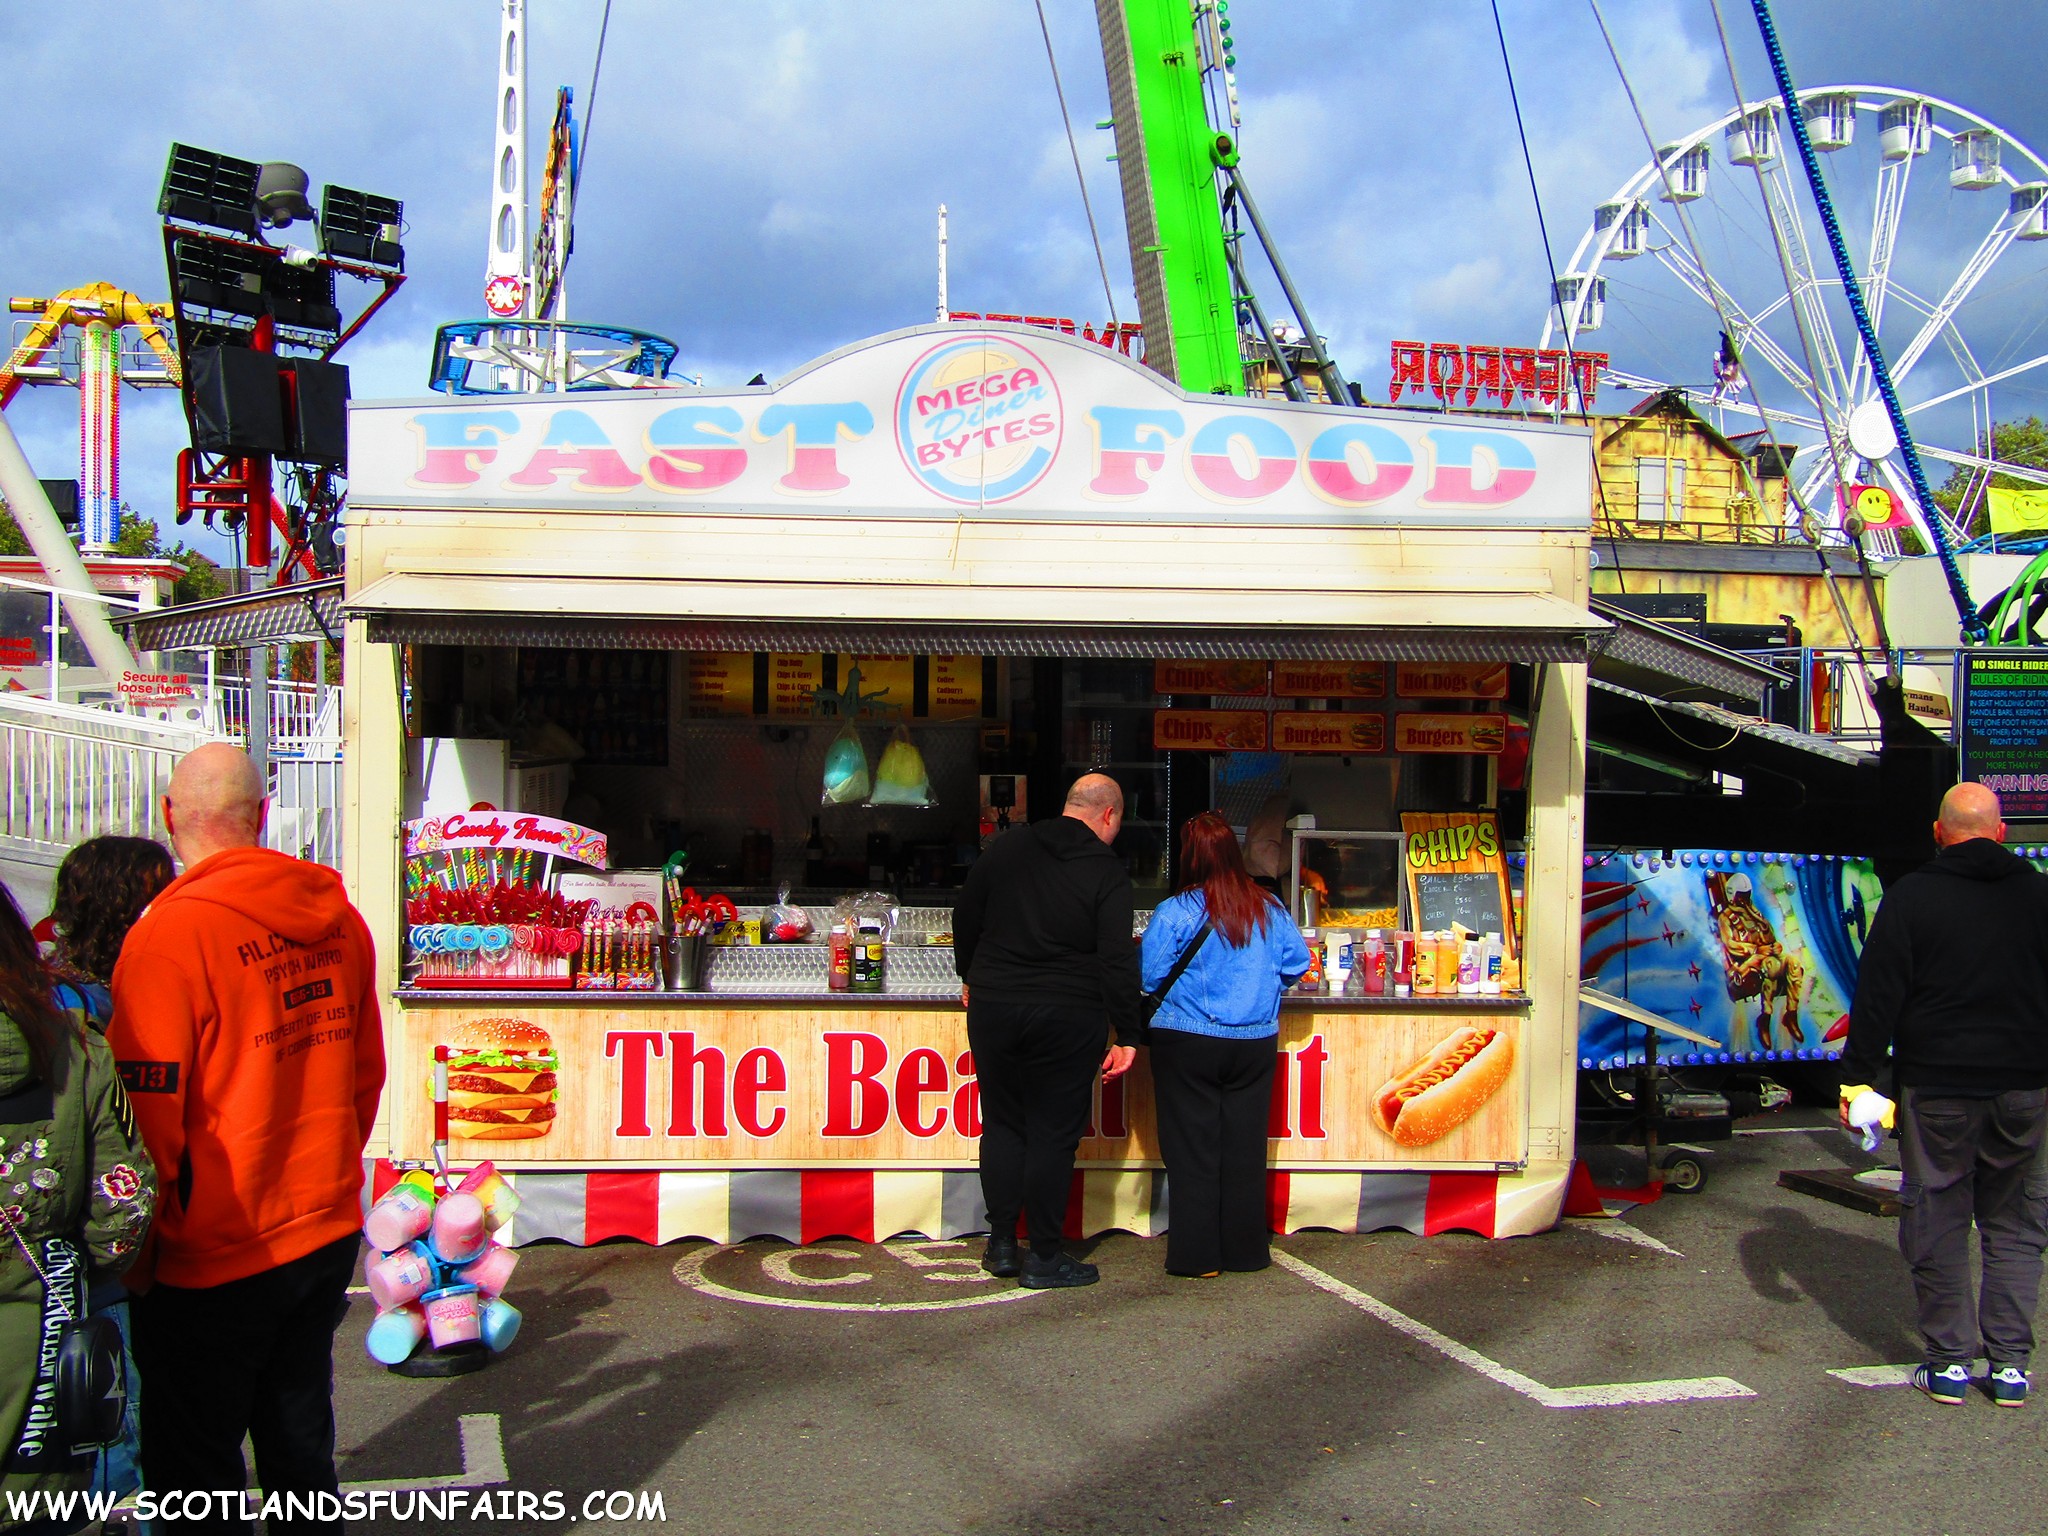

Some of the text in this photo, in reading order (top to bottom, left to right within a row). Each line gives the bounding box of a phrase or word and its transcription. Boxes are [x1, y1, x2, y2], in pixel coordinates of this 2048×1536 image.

[917, 368, 1039, 416] MEGA
[924, 386, 1048, 441] Diner
[917, 414, 1055, 467] BYTES
[405, 401, 1536, 509] FAST FOOD
[1972, 660, 1986, 670] NO
[1987, 660, 2021, 670] SINGLE
[122, 671, 188, 684] Secure all
[1165, 668, 1214, 690] Chips
[1285, 673, 1343, 692] Burgers
[1404, 672, 1468, 692] Hot Dogs
[1972, 674, 2003, 684] RULES
[2005, 674, 2020, 684] OF
[117, 682, 192, 695] loose items
[1970, 690, 2007, 698] PASSENGERS
[2009, 690, 2026, 698] MUST
[1908, 702, 1944, 716] Haulage
[1978, 699, 1993, 707] SEAT
[1994, 699, 2024, 707] HOLDING
[2025, 699, 2046, 707] ONTO
[1970, 708, 1997, 716] HANDLE
[2015, 708, 2042, 717] KEEPING
[1163, 718, 1212, 743] Chips
[1967, 718, 1983, 726] FEET
[2001, 718, 2019, 726] FOOT
[1284, 727, 1342, 745] Burgers
[1406, 728, 1464, 747] Burgers
[1972, 728, 1985, 736] THE
[2011, 728, 2022, 736] ON
[2023, 728, 2035, 736] THE
[1989, 737, 2012, 746] FRONT
[2012, 737, 2022, 746] OF
[1968, 751, 1984, 759] YOU
[1985, 751, 2006, 759] MUST
[2006, 751, 2015, 759] BE
[2016, 751, 2026, 759] OF
[2027, 751, 2033, 759] A
[1978, 773, 2048, 792] WARNING
[442, 815, 565, 845] Candy Time
[1408, 821, 1499, 868] CHIPS
[264, 949, 343, 985] PSYCH WARD
[306, 1011, 322, 1026] OF
[326, 1007, 346, 1021] US
[605, 1030, 788, 1140] The
[431, 1299, 472, 1316] CANDY
[443, 1308, 473, 1320] FLOSS
